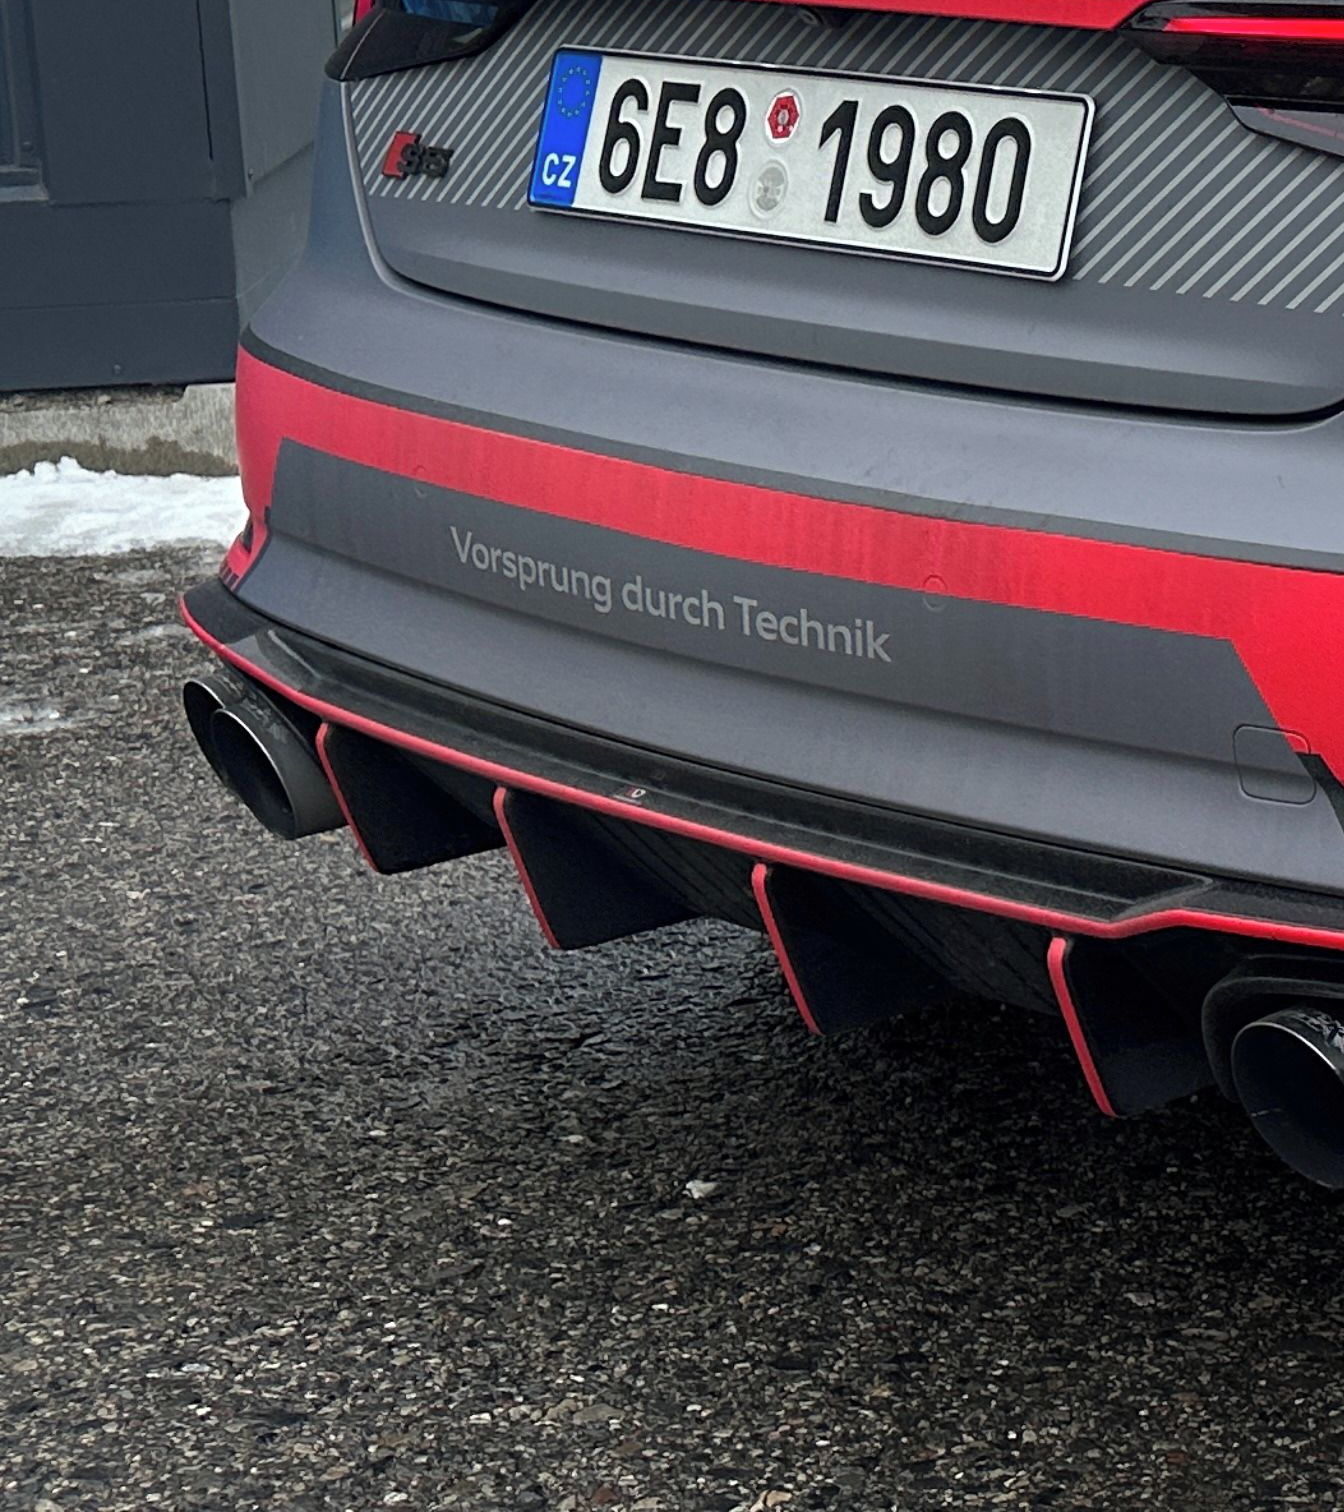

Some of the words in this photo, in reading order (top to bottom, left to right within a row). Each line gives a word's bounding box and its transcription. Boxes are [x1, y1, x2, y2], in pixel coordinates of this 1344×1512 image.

[541, 151, 578, 189] CZ
[598, 77, 748, 207] 6E8
[817, 99, 1032, 244] 1980
[449, 525, 613, 613] Vorsprung
[622, 575, 725, 631] durch
[733, 595, 893, 663] Technik
